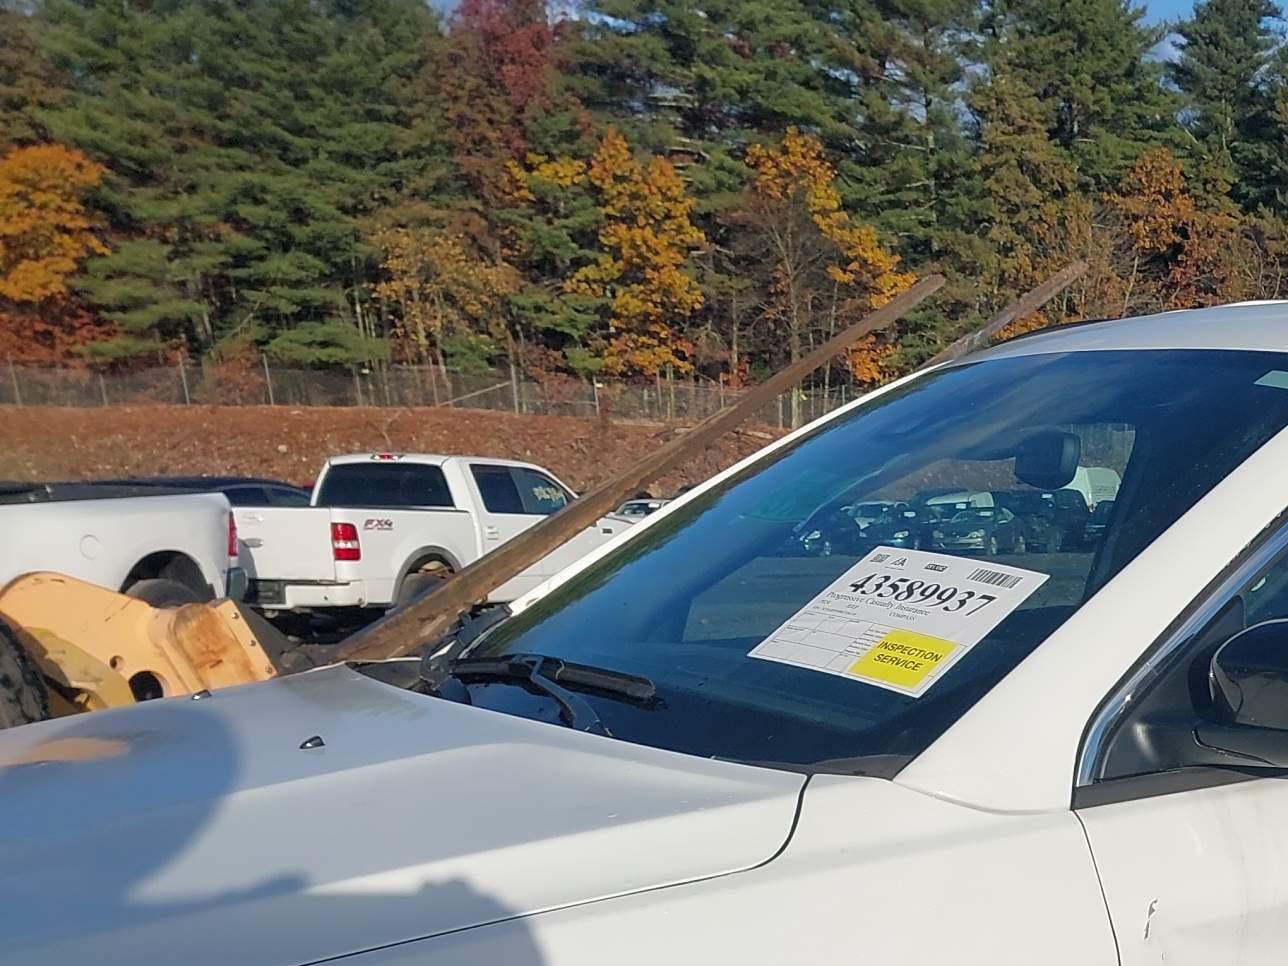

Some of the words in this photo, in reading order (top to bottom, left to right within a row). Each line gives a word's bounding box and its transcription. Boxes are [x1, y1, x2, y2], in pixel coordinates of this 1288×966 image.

[364, 519, 393, 528] FX4
[826, 592, 865, 604] Progressive
[865, 597, 894, 610] Casualty
[895, 604, 931, 616] Insurance
[850, 573, 997, 616] 43589937
[873, 653, 925, 672] SERVICE
[878, 641, 942, 663] INSPECTION
